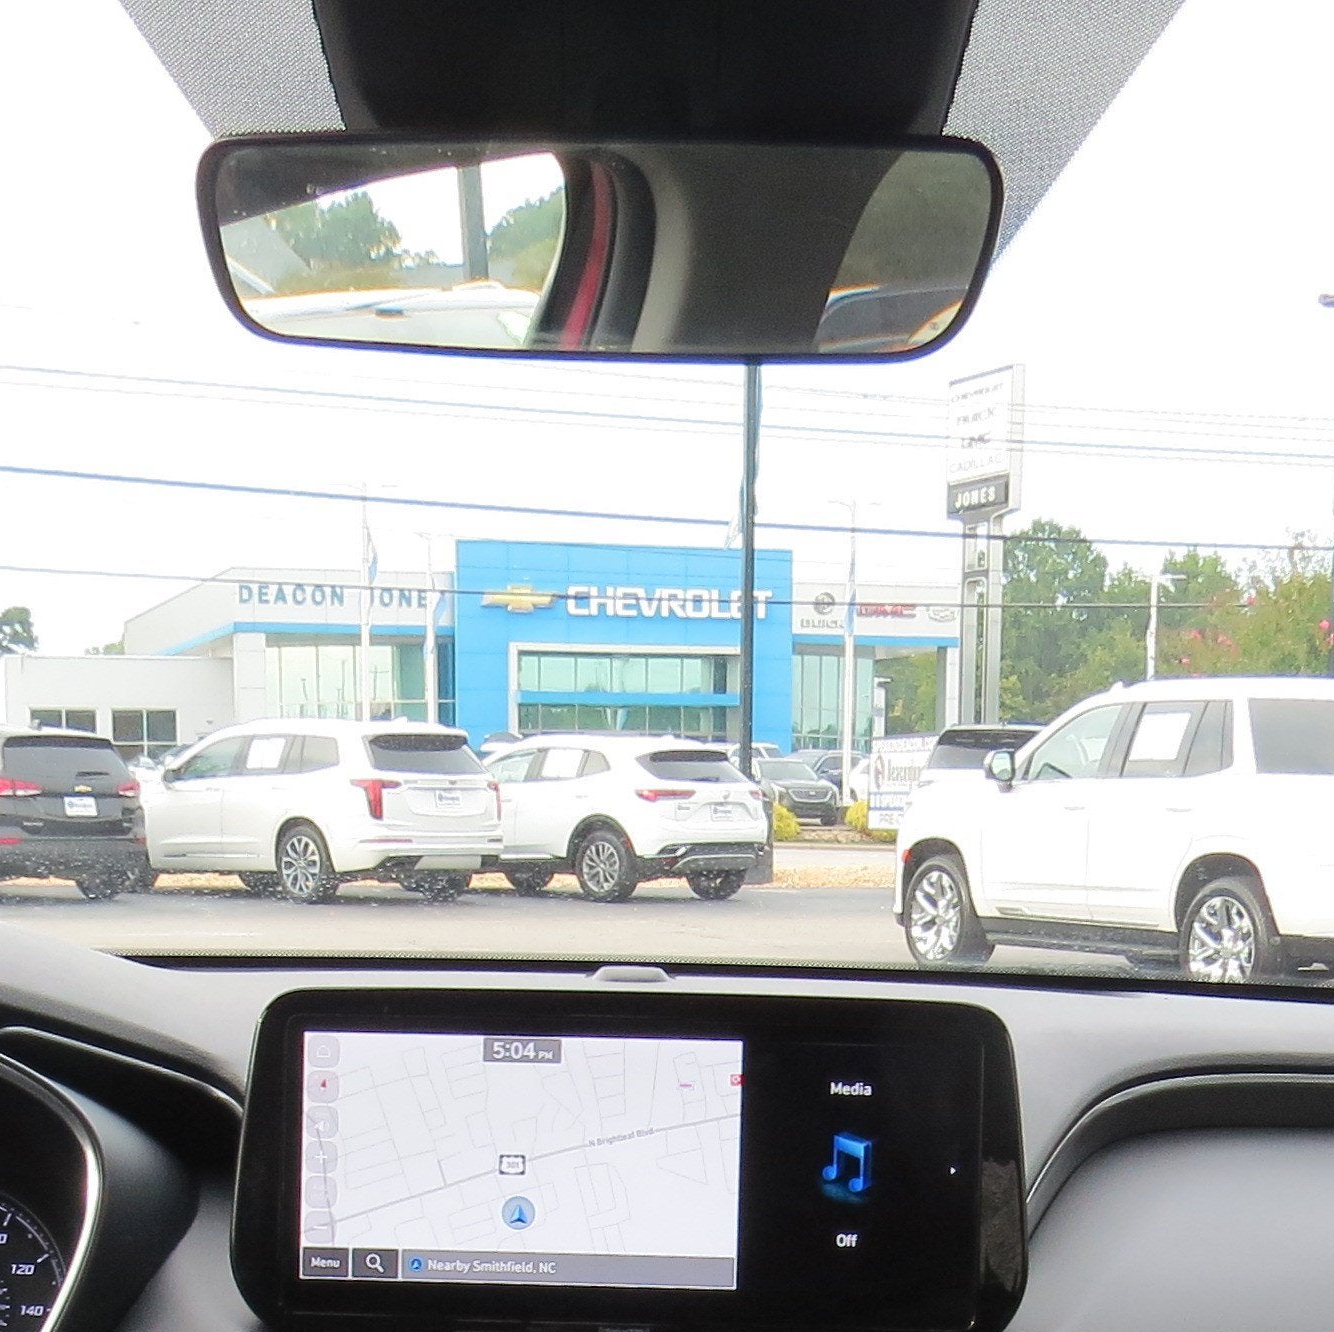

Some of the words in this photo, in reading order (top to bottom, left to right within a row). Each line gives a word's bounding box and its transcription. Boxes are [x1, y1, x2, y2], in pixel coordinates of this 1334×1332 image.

[949, 453, 1003, 474] CADILLAC
[955, 486, 996, 510] JONES
[237, 583, 346, 607] DEACON
[368, 587, 430, 609] JONE
[830, 1081, 872, 1097] Media
[835, 1233, 858, 1248] Off
[10, 1263, 35, 1275] 120
[310, 1256, 340, 1269] Menu
[427, 1258, 470, 1274] Nearby
[472, 1259, 537, 1275] Smithfield,
[539, 1261, 557, 1274] NC
[20, 1305, 44, 1316] 140
